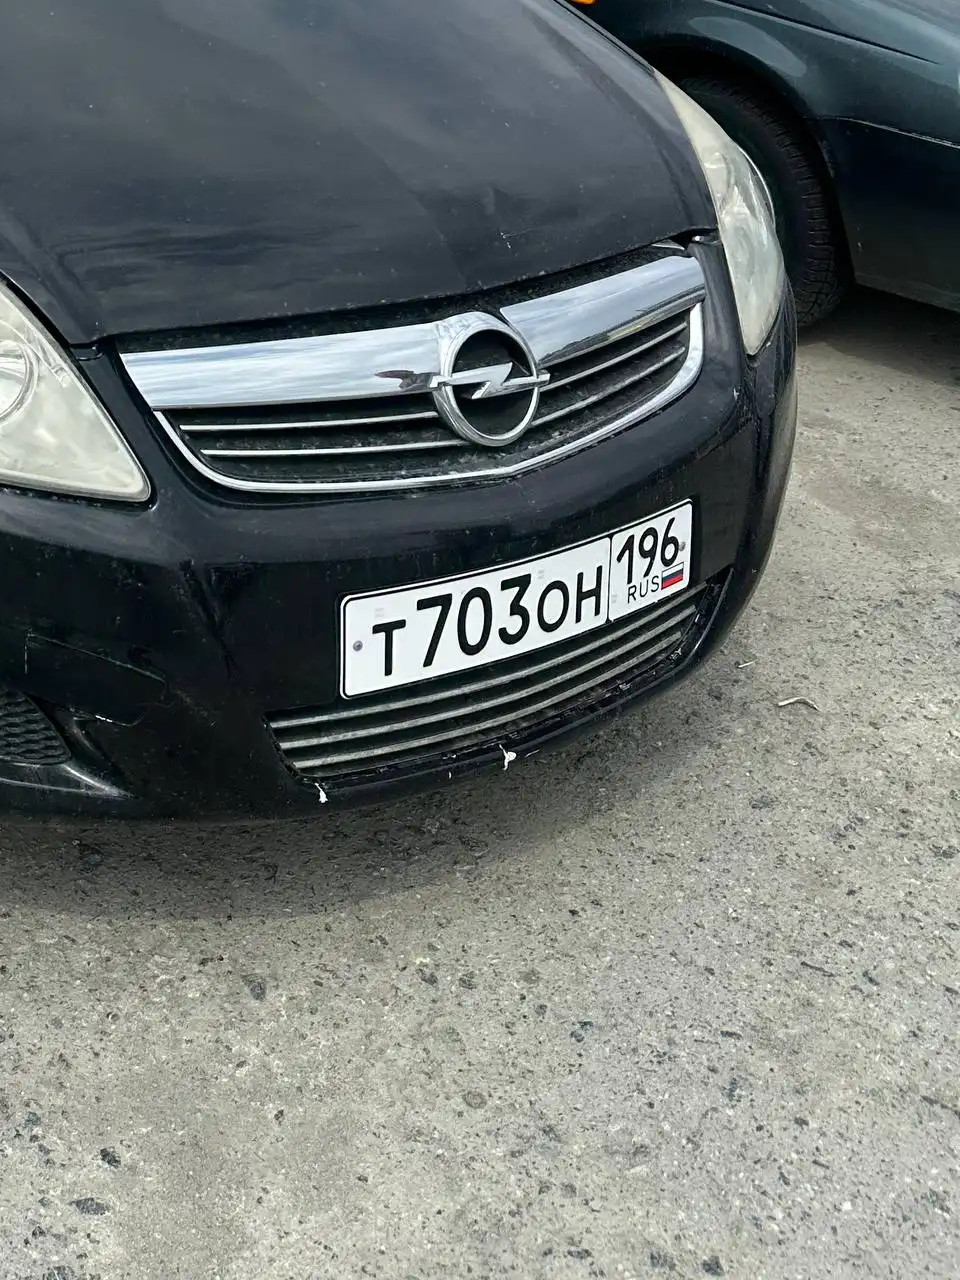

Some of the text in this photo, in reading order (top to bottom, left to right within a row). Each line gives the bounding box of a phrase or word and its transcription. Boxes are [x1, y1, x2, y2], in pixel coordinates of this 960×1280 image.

[372, 517, 680, 677] Т703ОН 196
[627, 575, 660, 605] RUS
